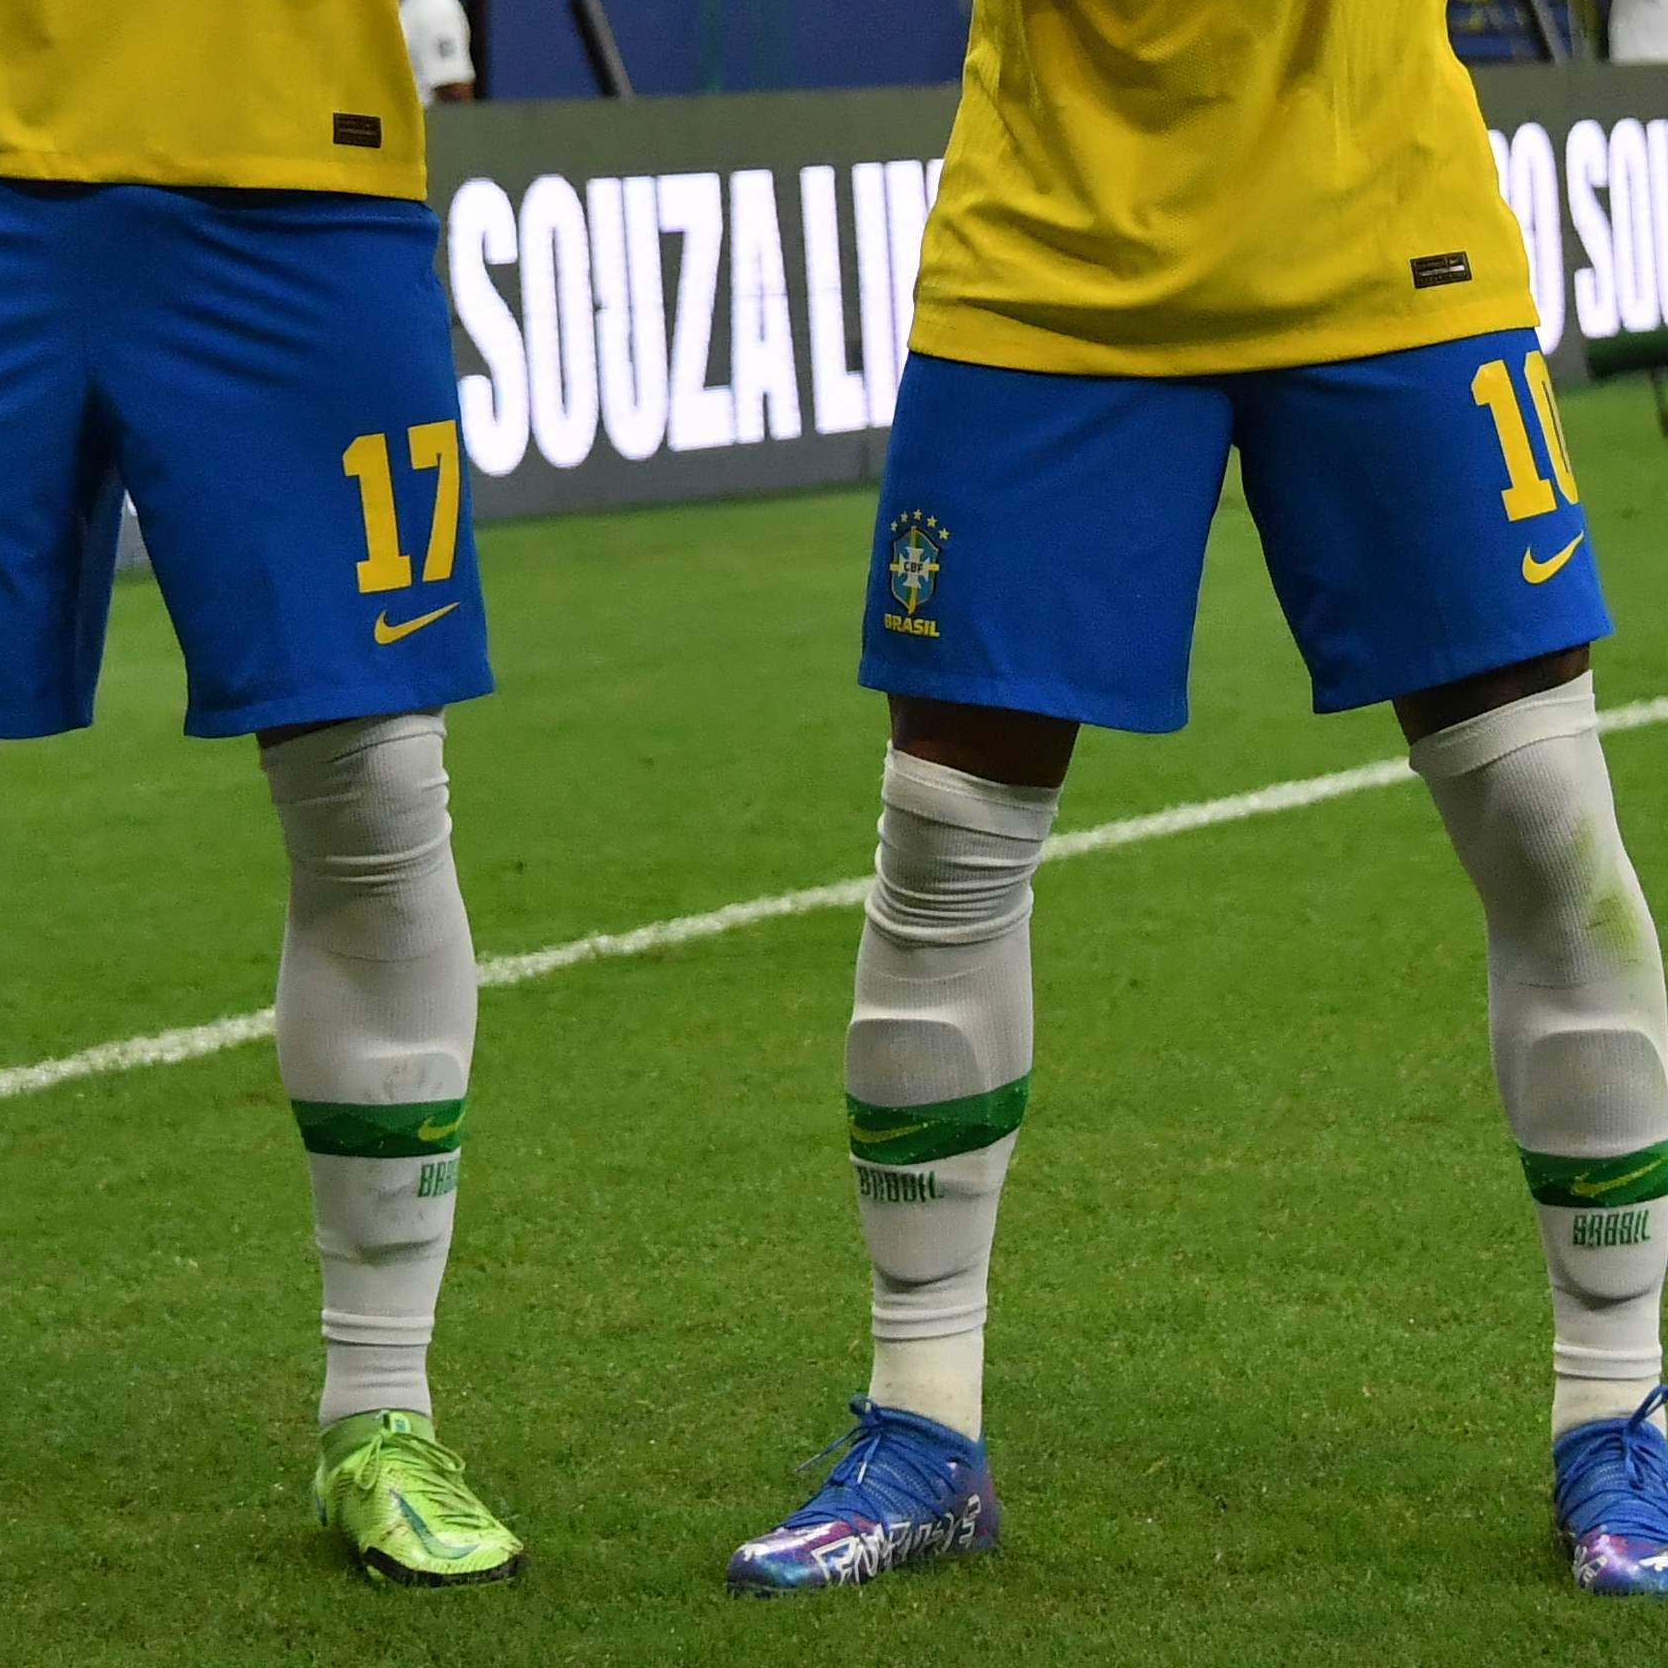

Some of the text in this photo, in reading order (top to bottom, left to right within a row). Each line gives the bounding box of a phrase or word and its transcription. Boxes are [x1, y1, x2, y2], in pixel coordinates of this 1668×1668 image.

[447, 170, 802, 476] SOUZA
[342, 419, 460, 593] 17
[884, 613, 941, 638] BRASIL
